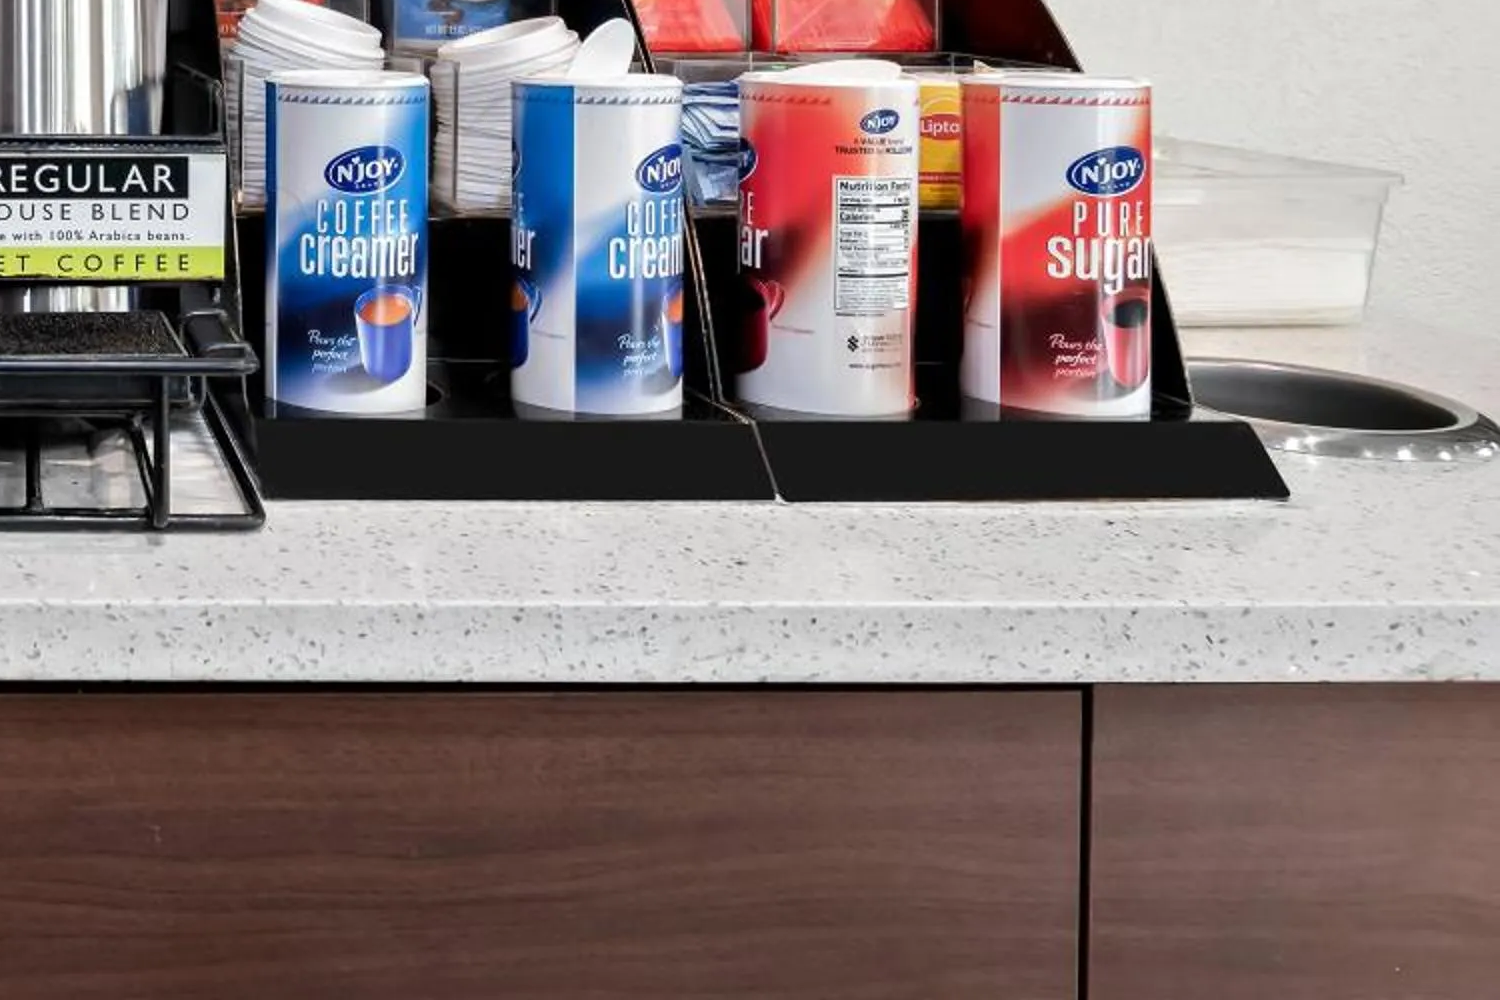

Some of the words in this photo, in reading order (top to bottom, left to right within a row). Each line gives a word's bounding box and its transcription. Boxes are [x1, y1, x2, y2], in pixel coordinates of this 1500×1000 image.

[921, 119, 961, 137] Lipto
[839, 181, 889, 191] Nutrition
[91, 203, 190, 222] BLEND
[317, 199, 409, 235] COFFEE
[1073, 201, 1145, 237] PURE
[11, 230, 43, 242] with
[49, 230, 84, 242] 100%
[88, 230, 142, 242] Arabica
[57, 253, 191, 272] COFFEE
[300, 232, 419, 279] creamer
[1055, 351, 1097, 367] perfect
